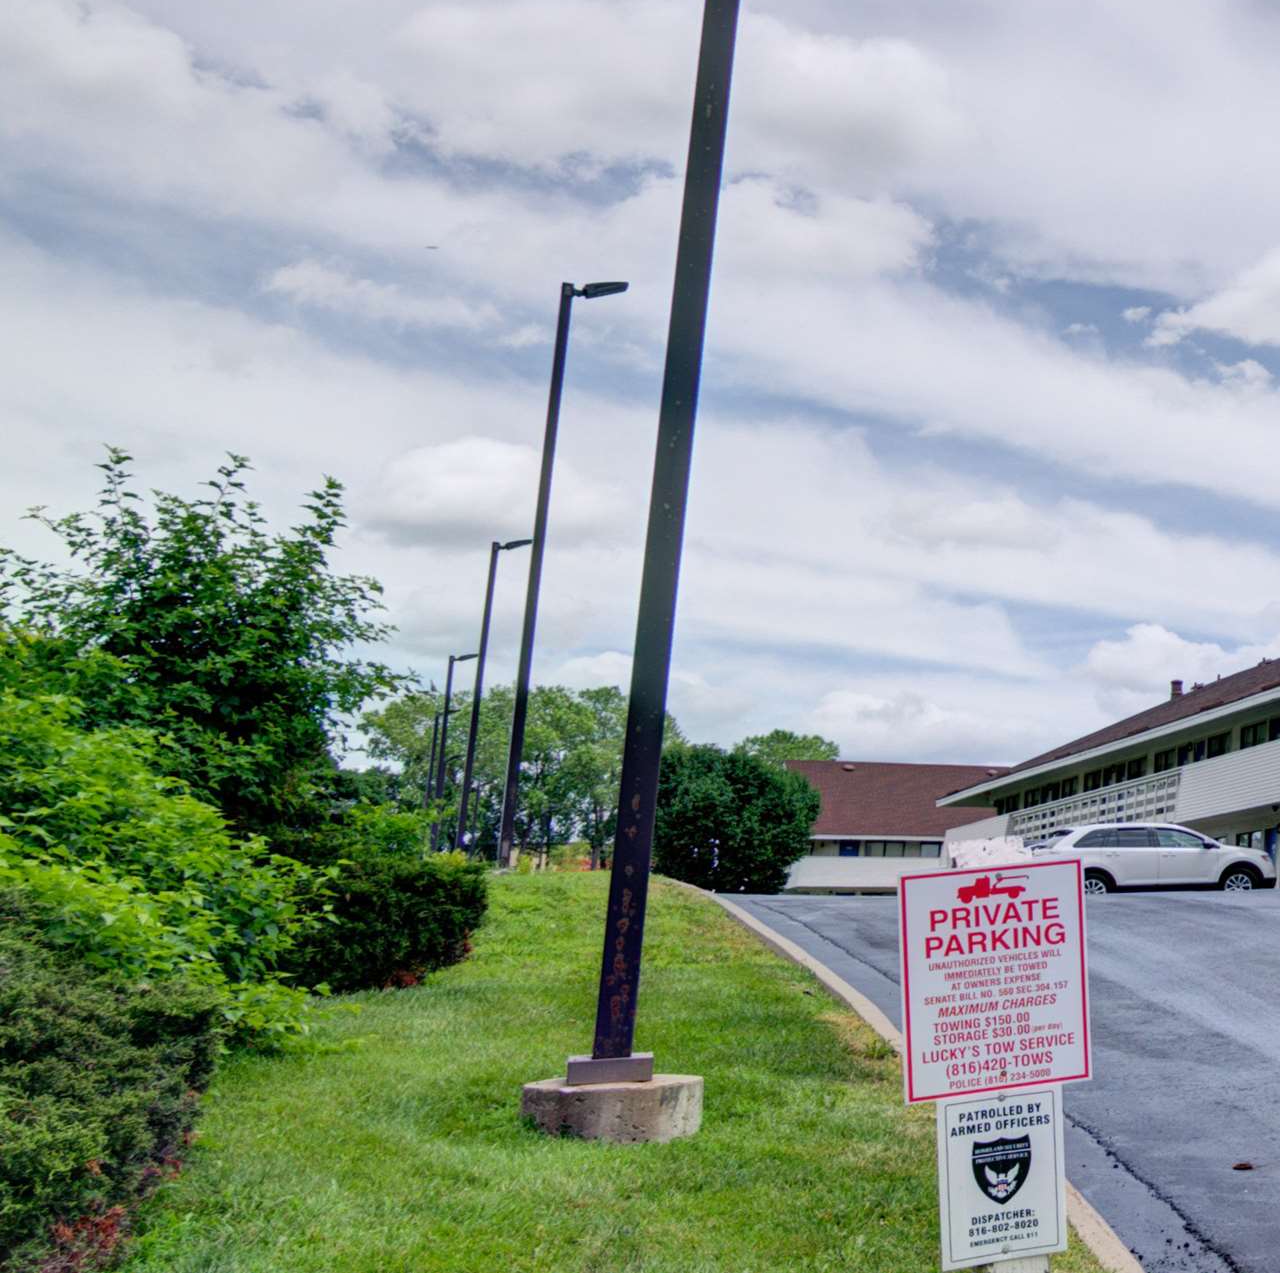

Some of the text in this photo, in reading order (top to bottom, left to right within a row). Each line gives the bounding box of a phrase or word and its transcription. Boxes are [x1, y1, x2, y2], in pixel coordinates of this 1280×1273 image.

[929, 897, 1061, 932] PRIVATE
[925, 923, 1066, 959] PARKING
[928, 948, 1062, 972] UNAUTHORIZED VEHICLES WILL
[944, 961, 1048, 981] IMMEDIATELY BE TOWED
[951, 973, 1041, 991] AT OWNERS EXPENSE
[924, 994, 956, 1006] SENATE
[959, 991, 977, 1001] BILL
[938, 994, 1057, 1018] MAXIMUM CHARGES
[934, 1012, 1030, 1033] TOWING $150.00
[934, 1030, 989, 1046] STORAGE
[992, 1024, 1031, 1038] $30.00
[922, 1032, 1075, 1064] LUCKY'S TOW SERVICE
[950, 1077, 982, 1089] POLICE
[958, 1102, 1042, 1123] PATROLLED BY
[950, 1114, 1050, 1137] ARMED OFFICERS
[971, 1209, 1036, 1225] DISPATCHER:
[969, 1236, 1008, 1248] EMERGENCY
[1009, 1233, 1025, 1241] CALL
